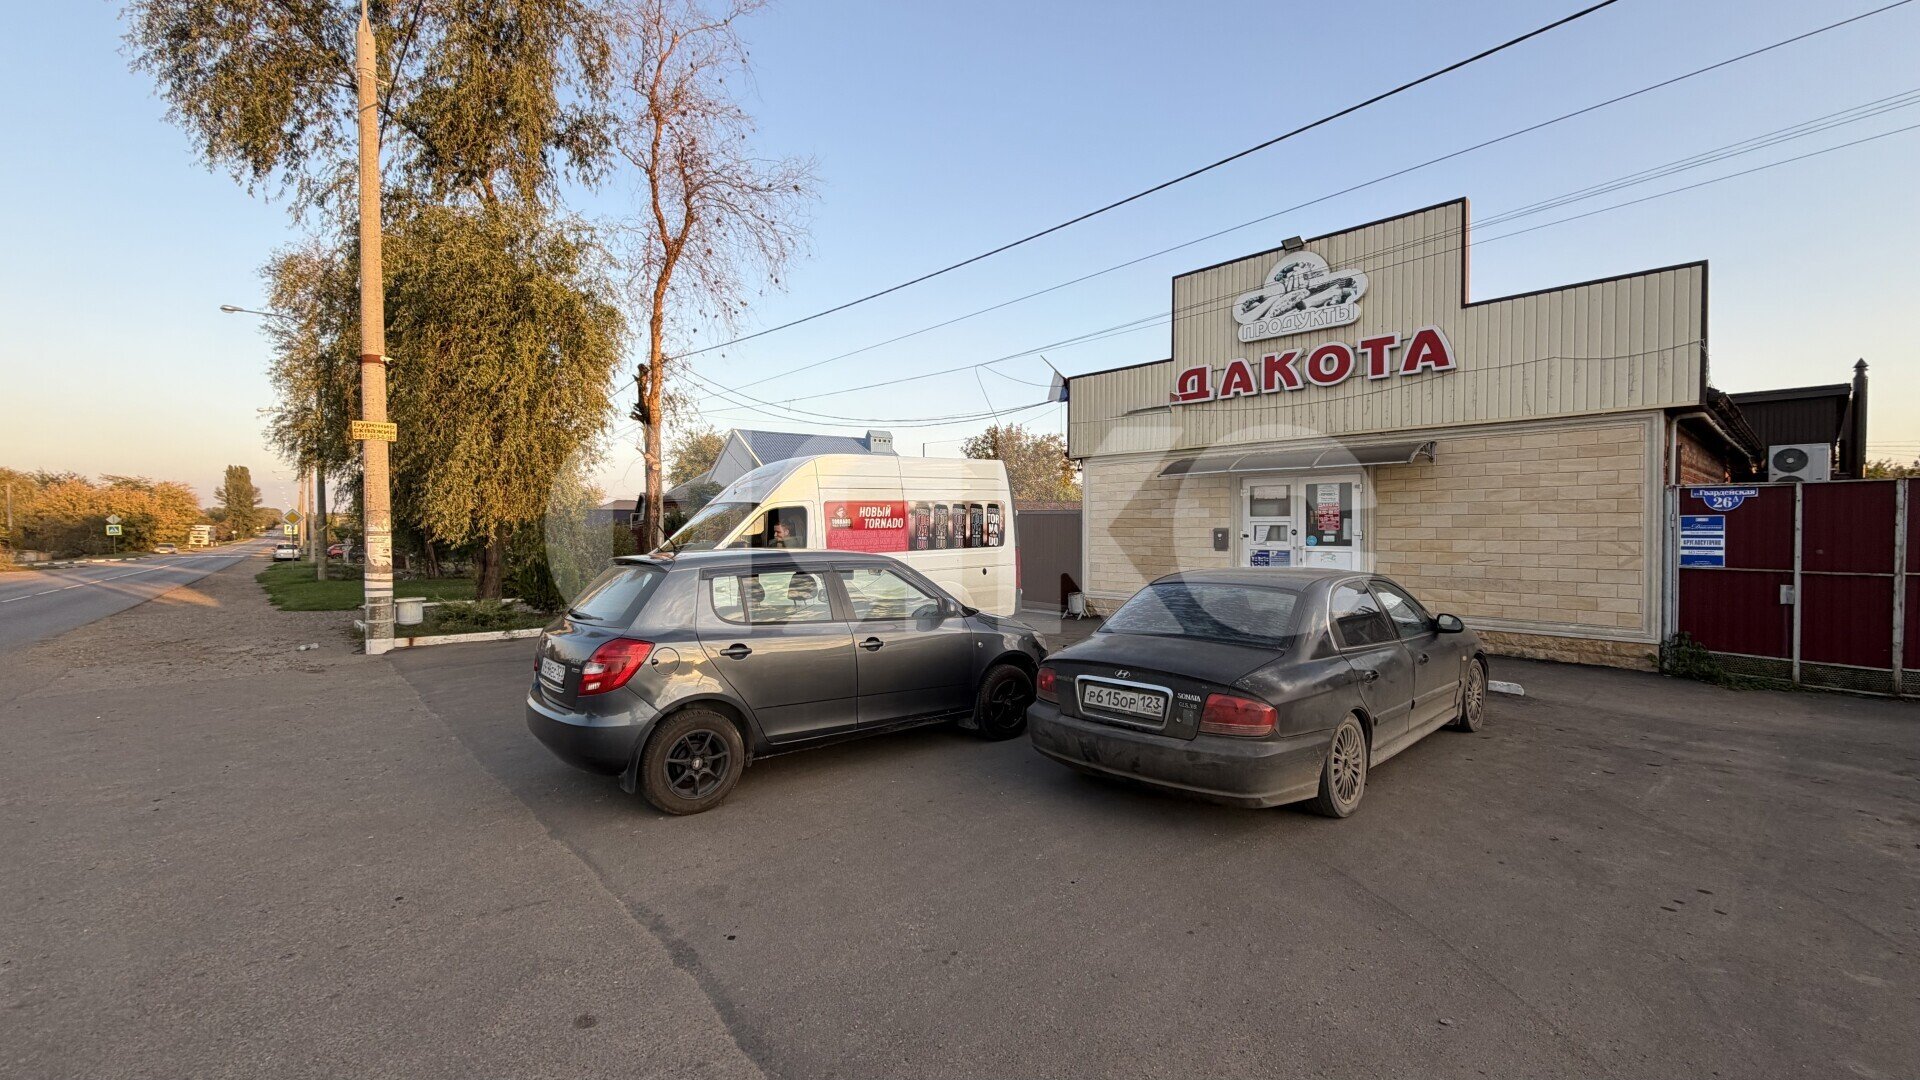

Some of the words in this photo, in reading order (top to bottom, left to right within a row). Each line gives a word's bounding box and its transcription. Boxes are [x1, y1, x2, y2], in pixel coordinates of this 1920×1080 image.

[1243, 303, 1355, 340] ПРОДУКТЫ
[1170, 326, 1456, 404] ДАКОТА
[859, 504, 892, 518] НОВЫЙ
[864, 518, 904, 529] TORNADO
[1140, 695, 1160, 710] 123
[1177, 692, 1201, 703] SONATA
